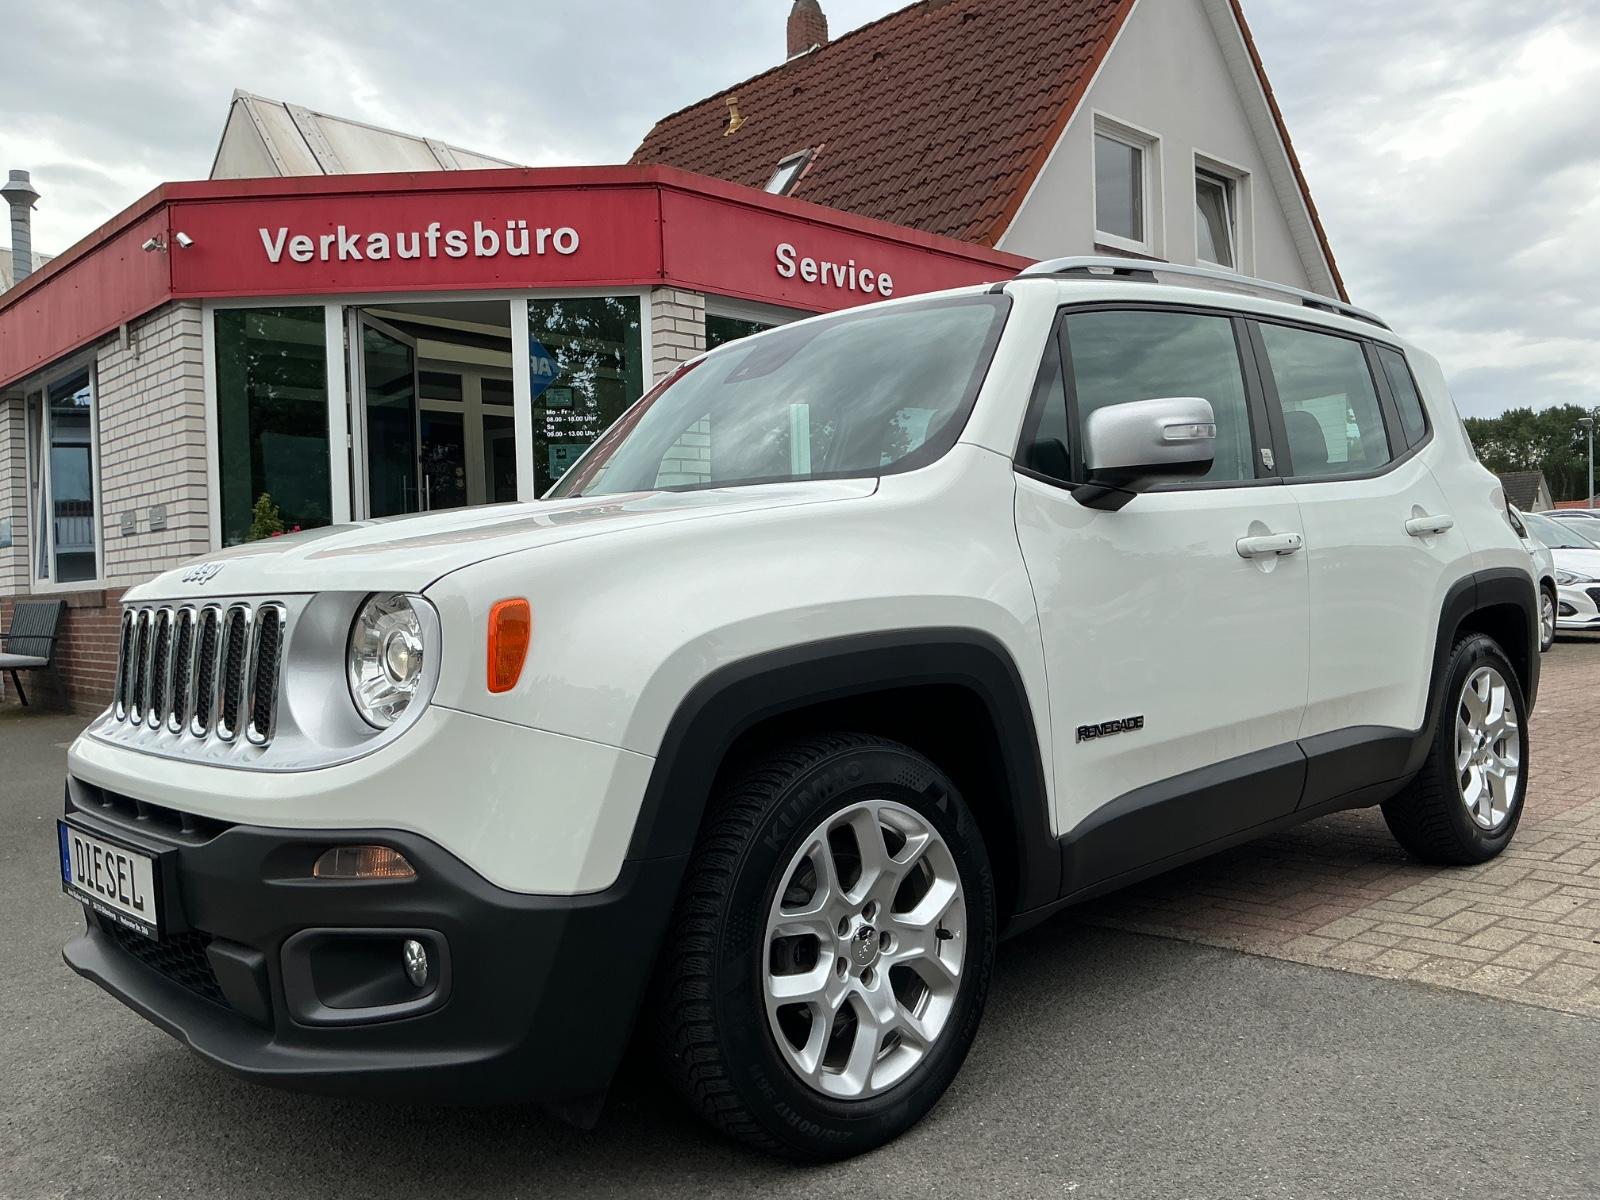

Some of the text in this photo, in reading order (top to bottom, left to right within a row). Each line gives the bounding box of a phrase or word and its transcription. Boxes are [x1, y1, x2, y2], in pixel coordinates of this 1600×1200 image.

[258, 219, 580, 264] Verkaufsbüro
[776, 243, 893, 296] Service
[1076, 715, 1144, 744] RENEGADE
[763, 760, 864, 852] KUMHO
[75, 835, 144, 911] DIESEL
